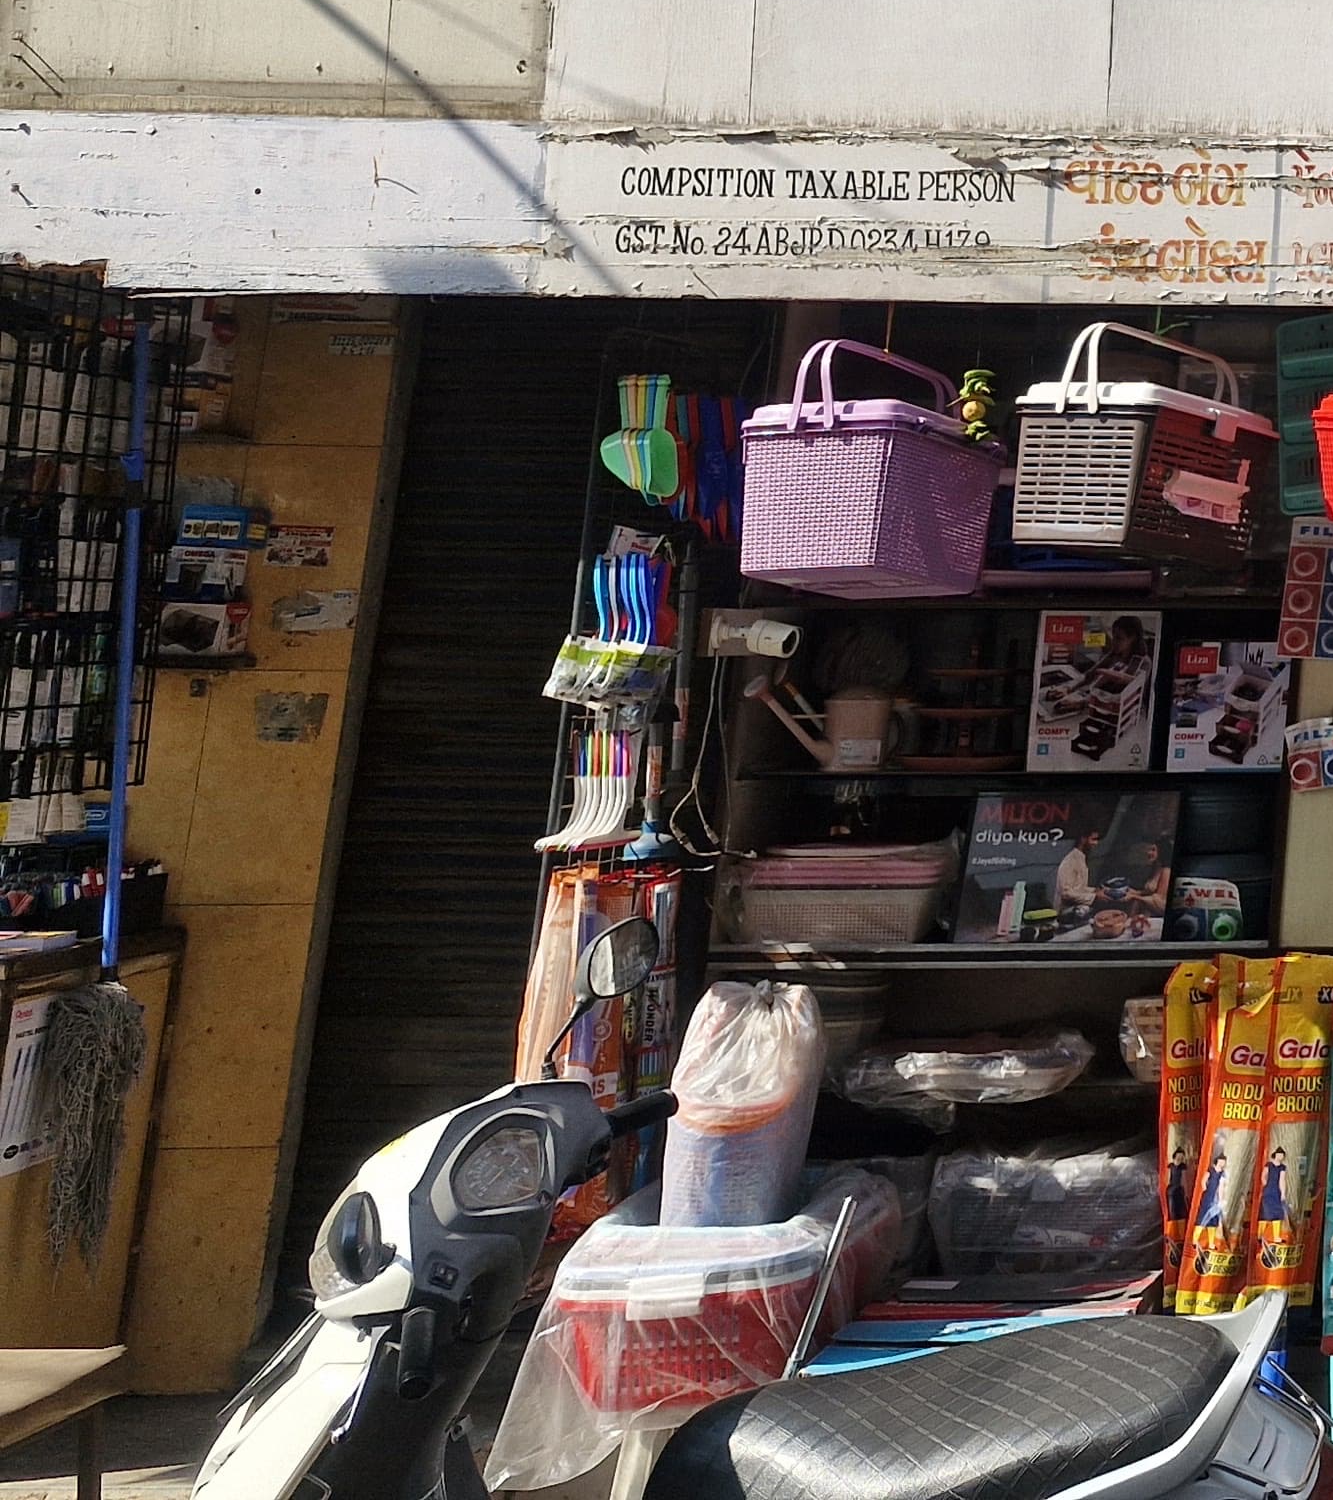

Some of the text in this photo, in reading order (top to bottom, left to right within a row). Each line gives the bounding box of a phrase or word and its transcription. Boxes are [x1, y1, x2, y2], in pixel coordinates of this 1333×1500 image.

[621, 166, 1018, 203] COMPSITION TAXABLE PERSON
[1052, 622, 1076, 635] Liza
[1186, 653, 1210, 666] Liza
[978, 801, 1072, 826] MILTON
[975, 827, 1065, 848] diya kya?
[1221, 1082, 1242, 1100] NO
[1272, 1076, 1294, 1094] NO
